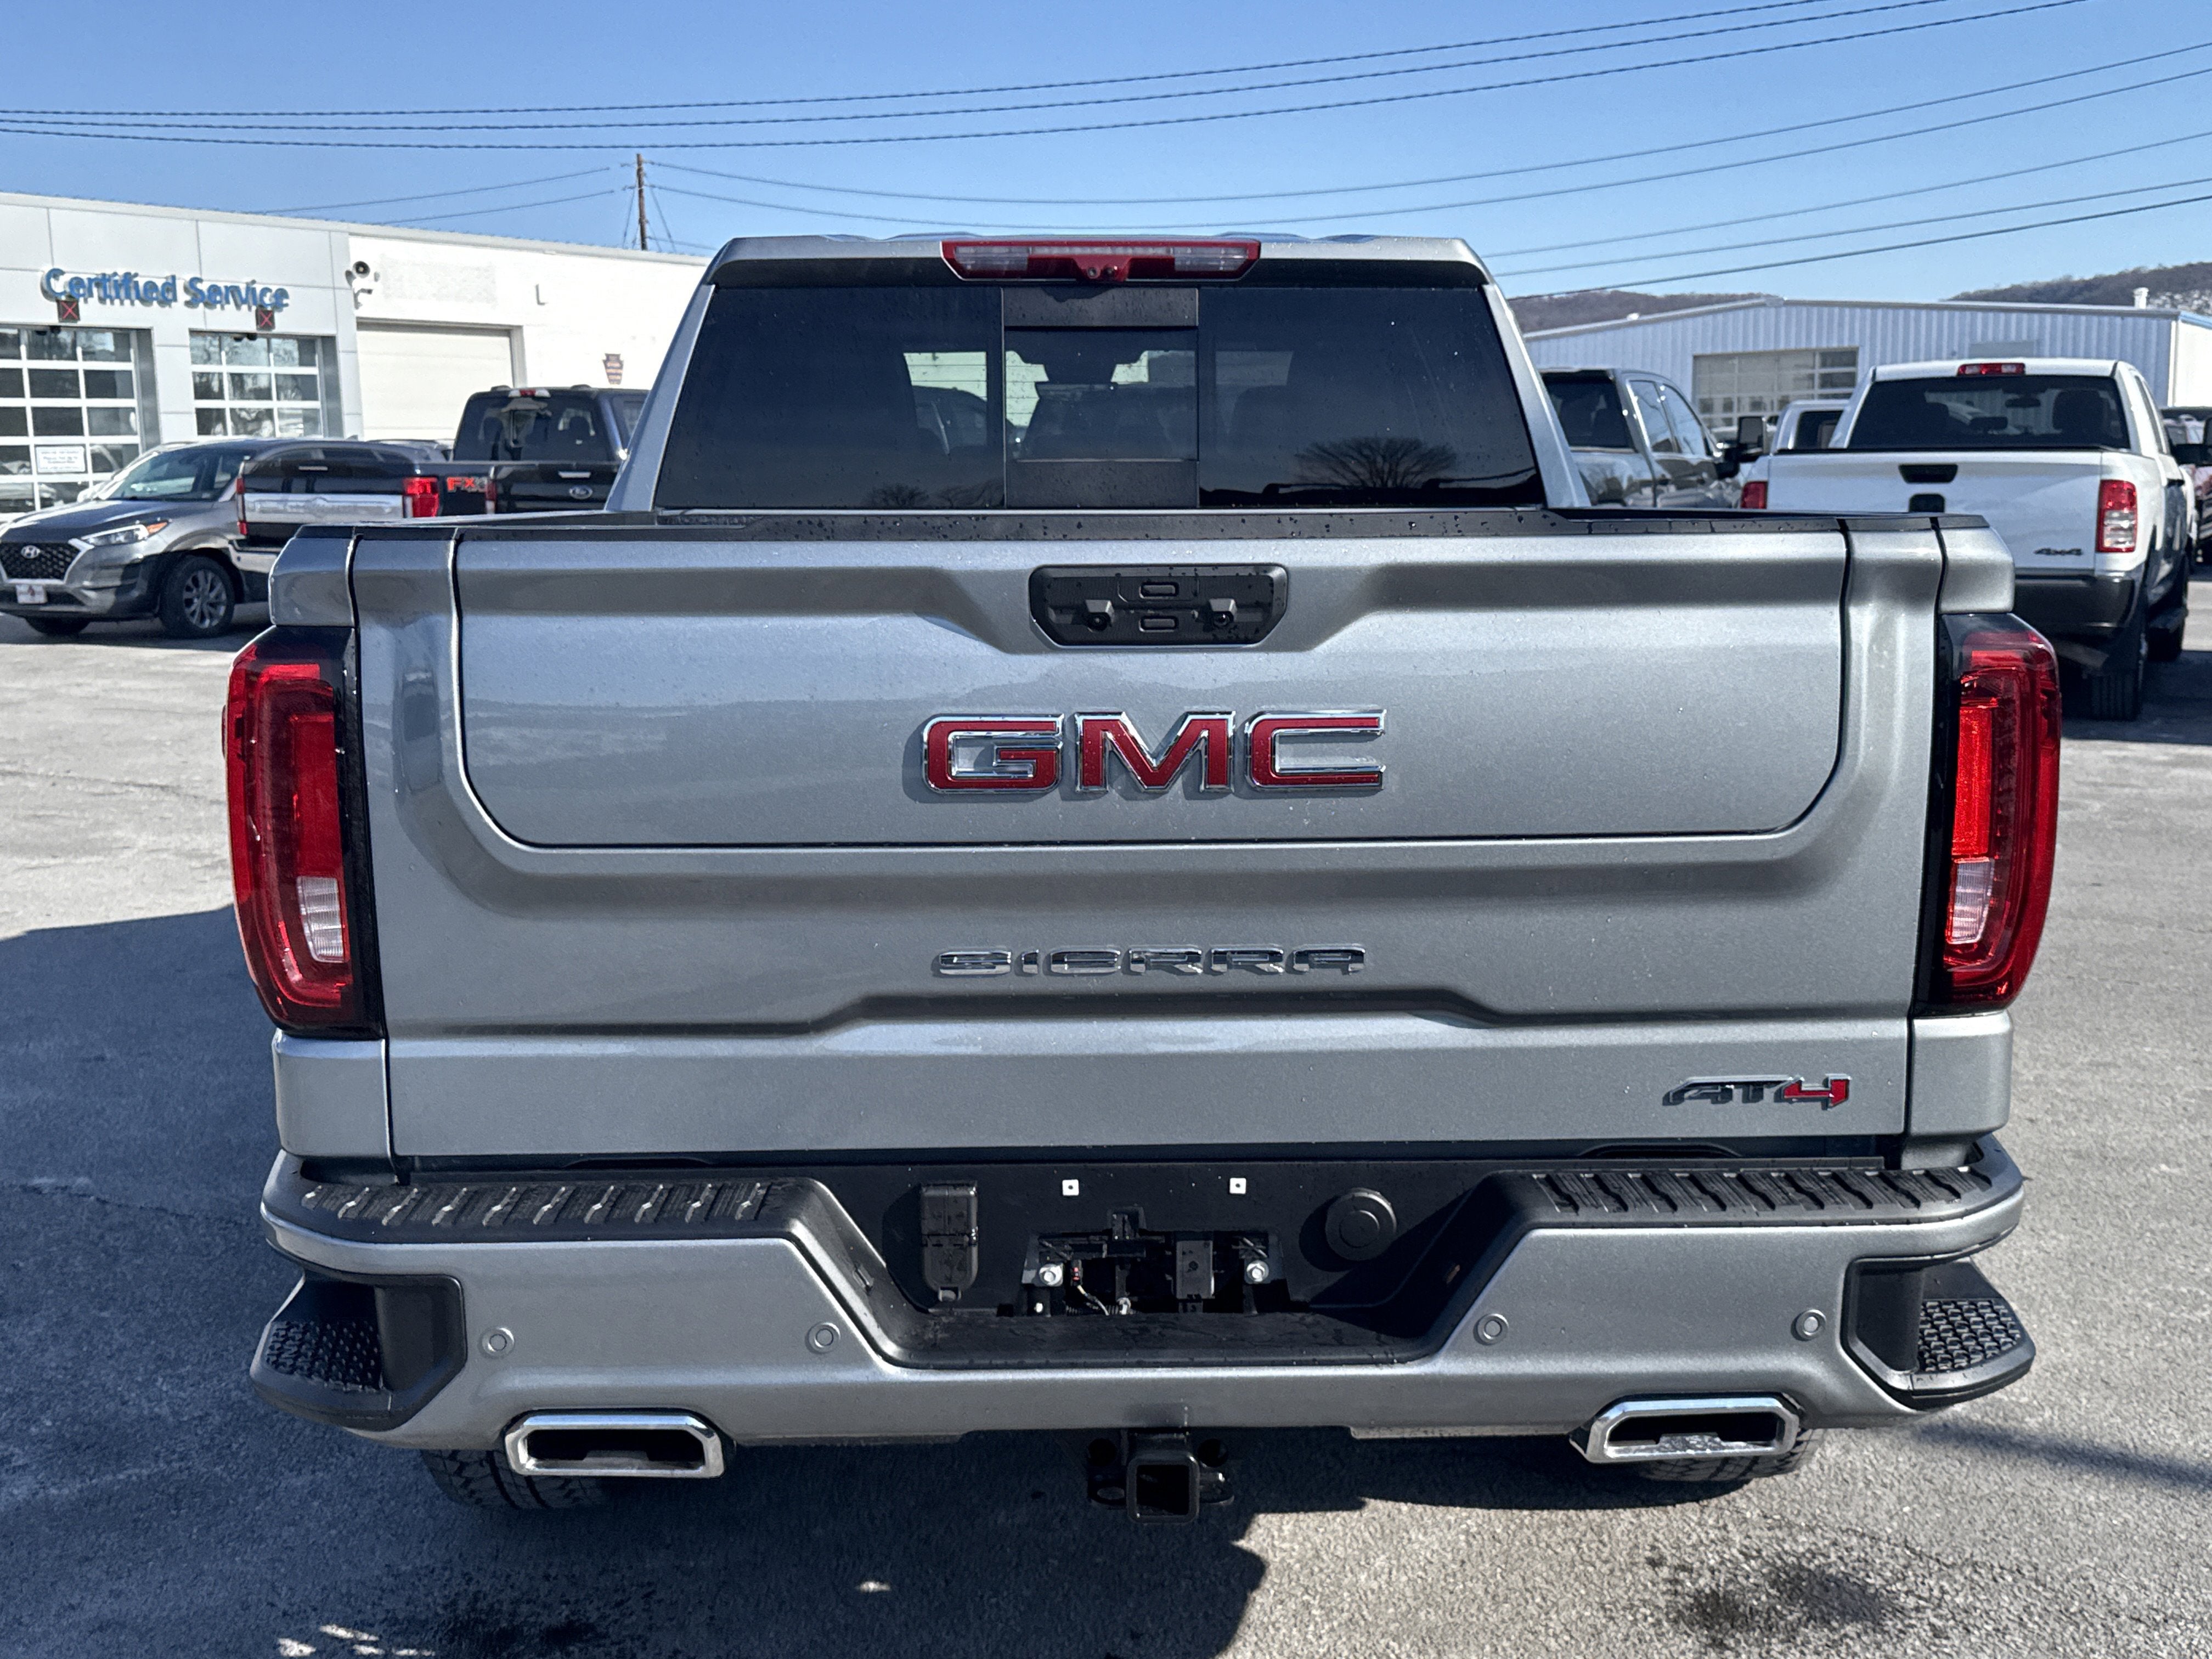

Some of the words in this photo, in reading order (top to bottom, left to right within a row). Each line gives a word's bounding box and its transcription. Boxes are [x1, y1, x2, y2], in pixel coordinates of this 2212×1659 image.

[44, 268, 177, 305] Certified
[185, 276, 289, 311] Service
[923, 709, 1386, 793] GMC
[938, 944, 1366, 974] SIERRA
[1663, 1074, 1851, 1110] AT4
